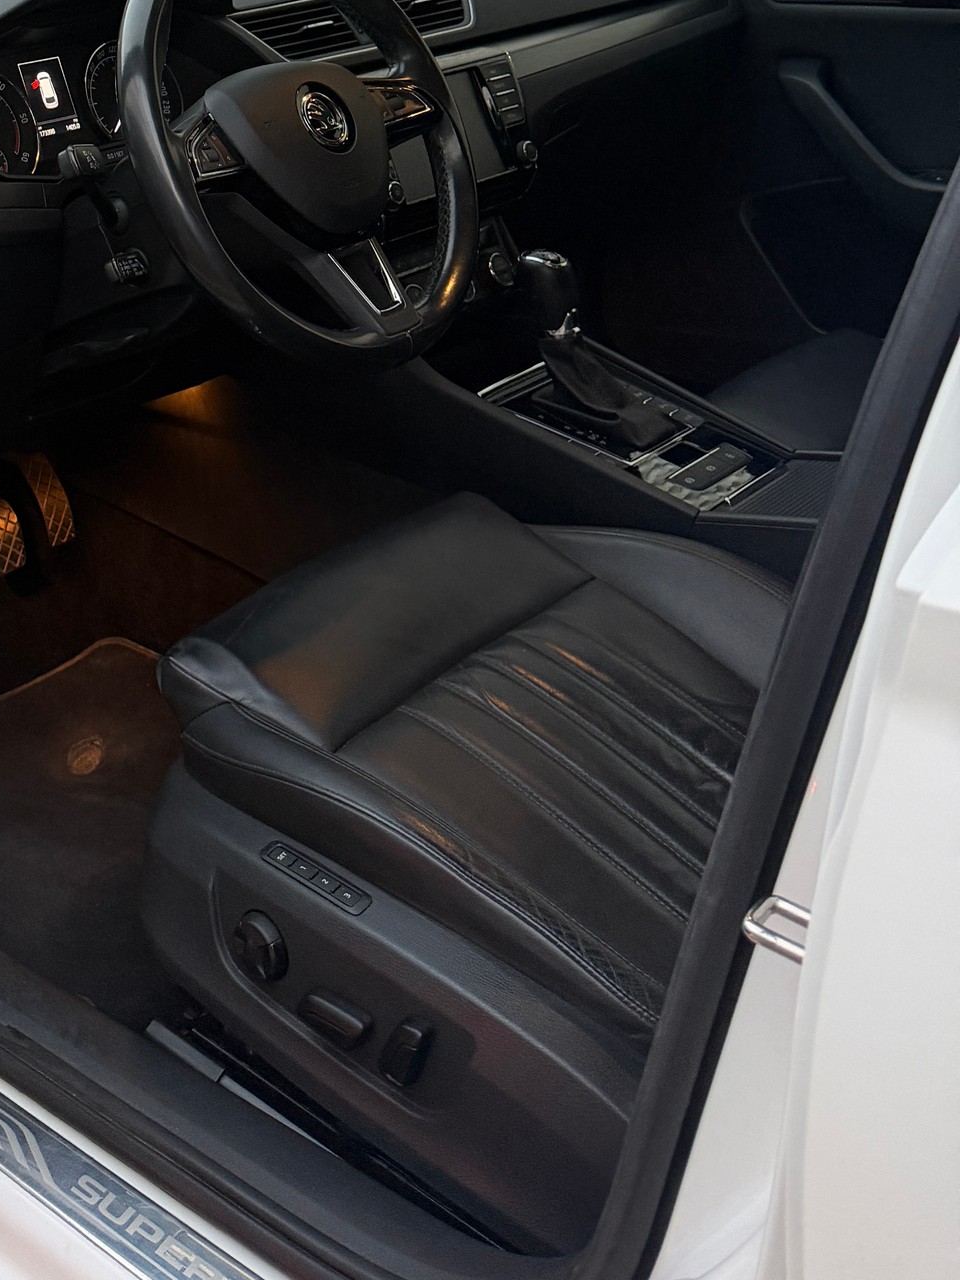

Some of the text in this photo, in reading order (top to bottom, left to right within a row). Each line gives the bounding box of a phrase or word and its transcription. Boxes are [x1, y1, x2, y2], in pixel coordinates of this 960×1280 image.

[19, 112, 29, 125] 50
[21, 151, 30, 163] 60
[70, 1174, 224, 1280] SUPER
